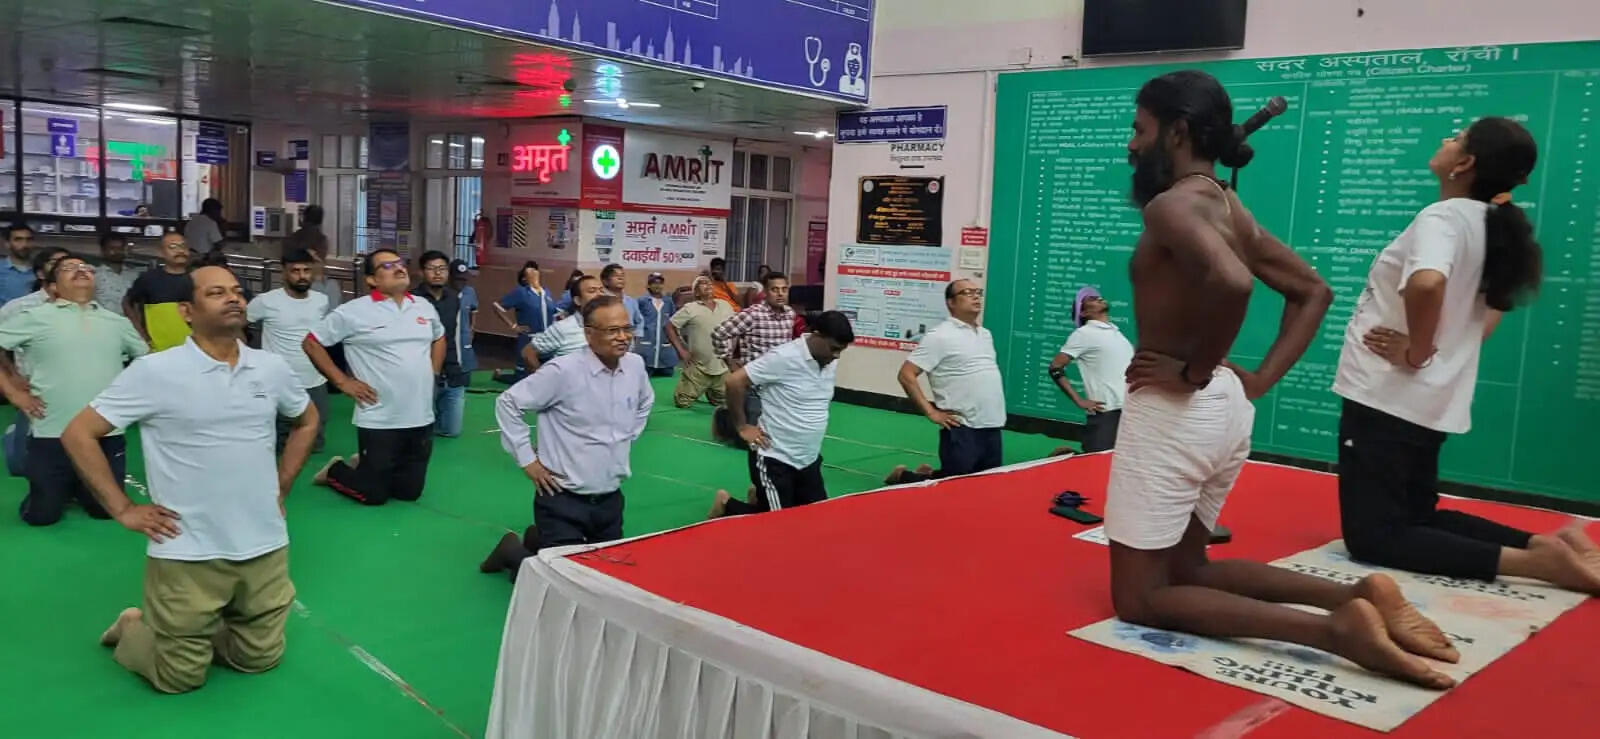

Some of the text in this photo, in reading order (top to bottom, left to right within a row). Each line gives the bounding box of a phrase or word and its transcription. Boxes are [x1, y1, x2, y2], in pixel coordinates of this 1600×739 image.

[1256, 60, 1308, 72] सदर
[890, 143, 945, 152] PHARMACY
[512, 144, 570, 184] अमृत
[625, 221, 657, 239] अमृत
[1212, 655, 1377, 704] KILLING
